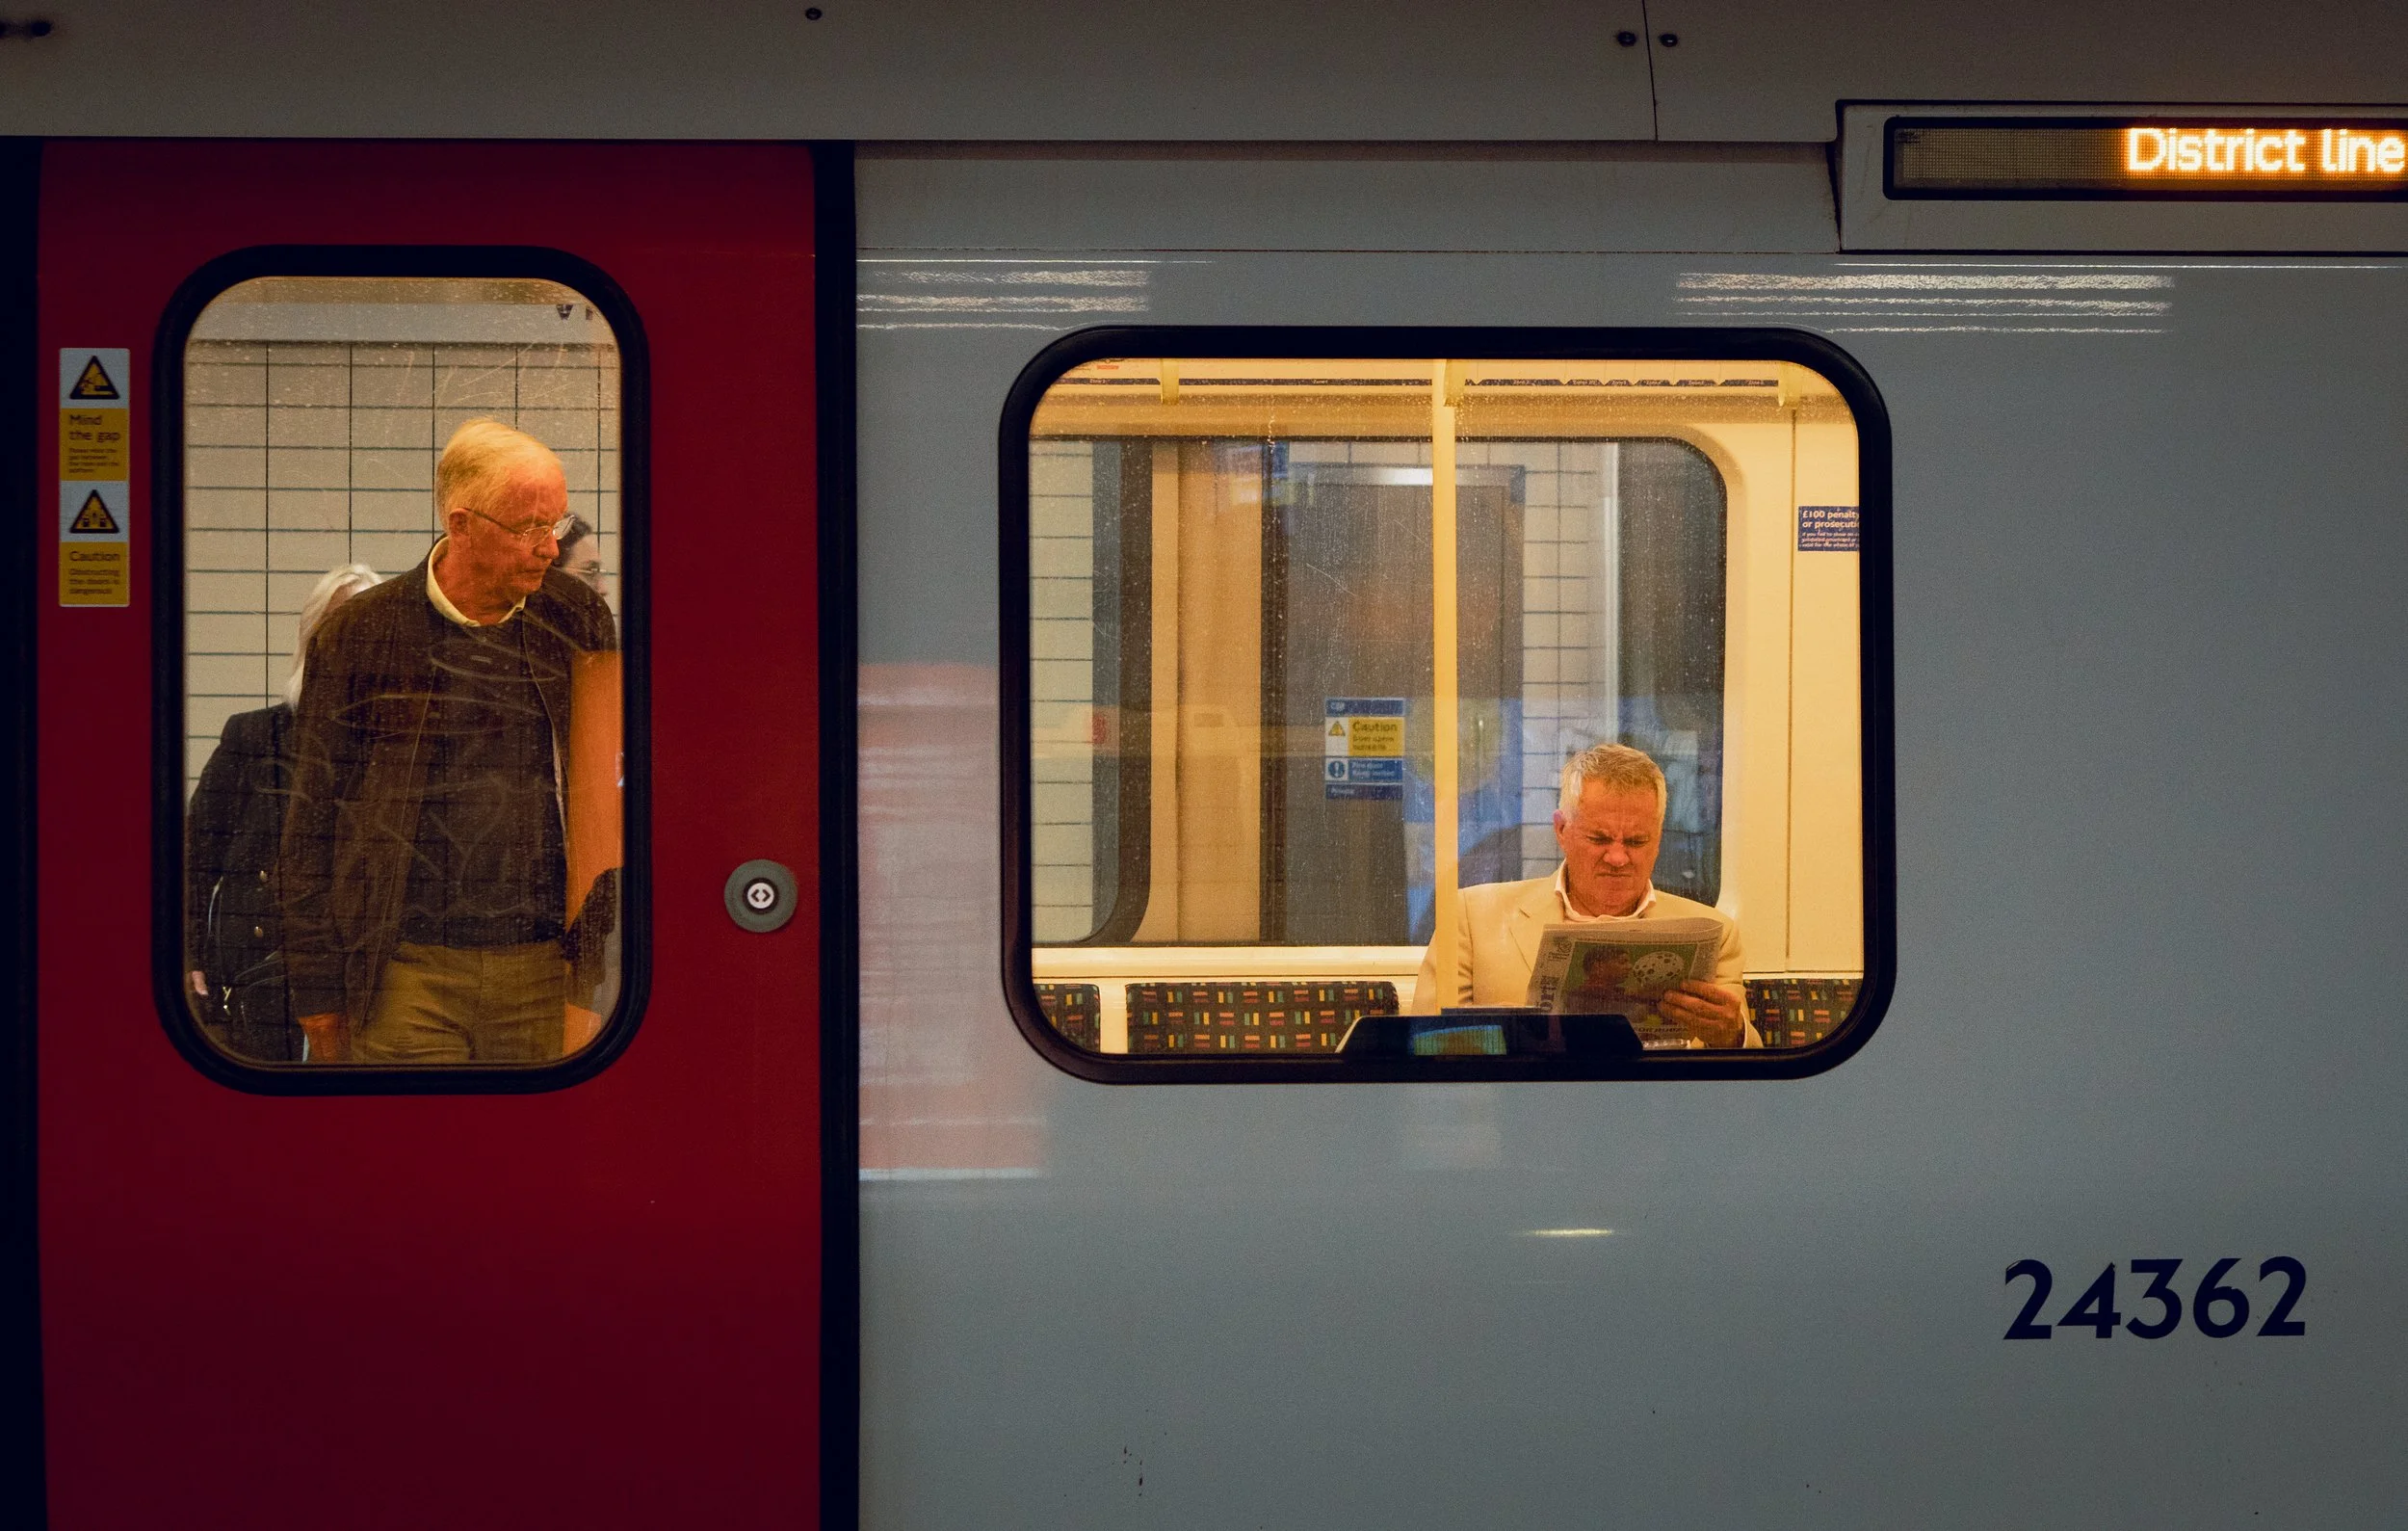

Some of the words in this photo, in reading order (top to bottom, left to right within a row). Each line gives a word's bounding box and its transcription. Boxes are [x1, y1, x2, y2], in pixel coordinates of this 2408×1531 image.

[2127, 128, 2306, 172] District
[2321, 128, 2406, 172] line
[69, 414, 102, 426] Mind
[69, 431, 92, 441] the
[97, 432, 120, 442] gap
[1803, 510, 1825, 518] £100
[69, 550, 120, 562] Caution
[1352, 722, 1398, 732] Caution
[2003, 1256, 2307, 1339] 24362
